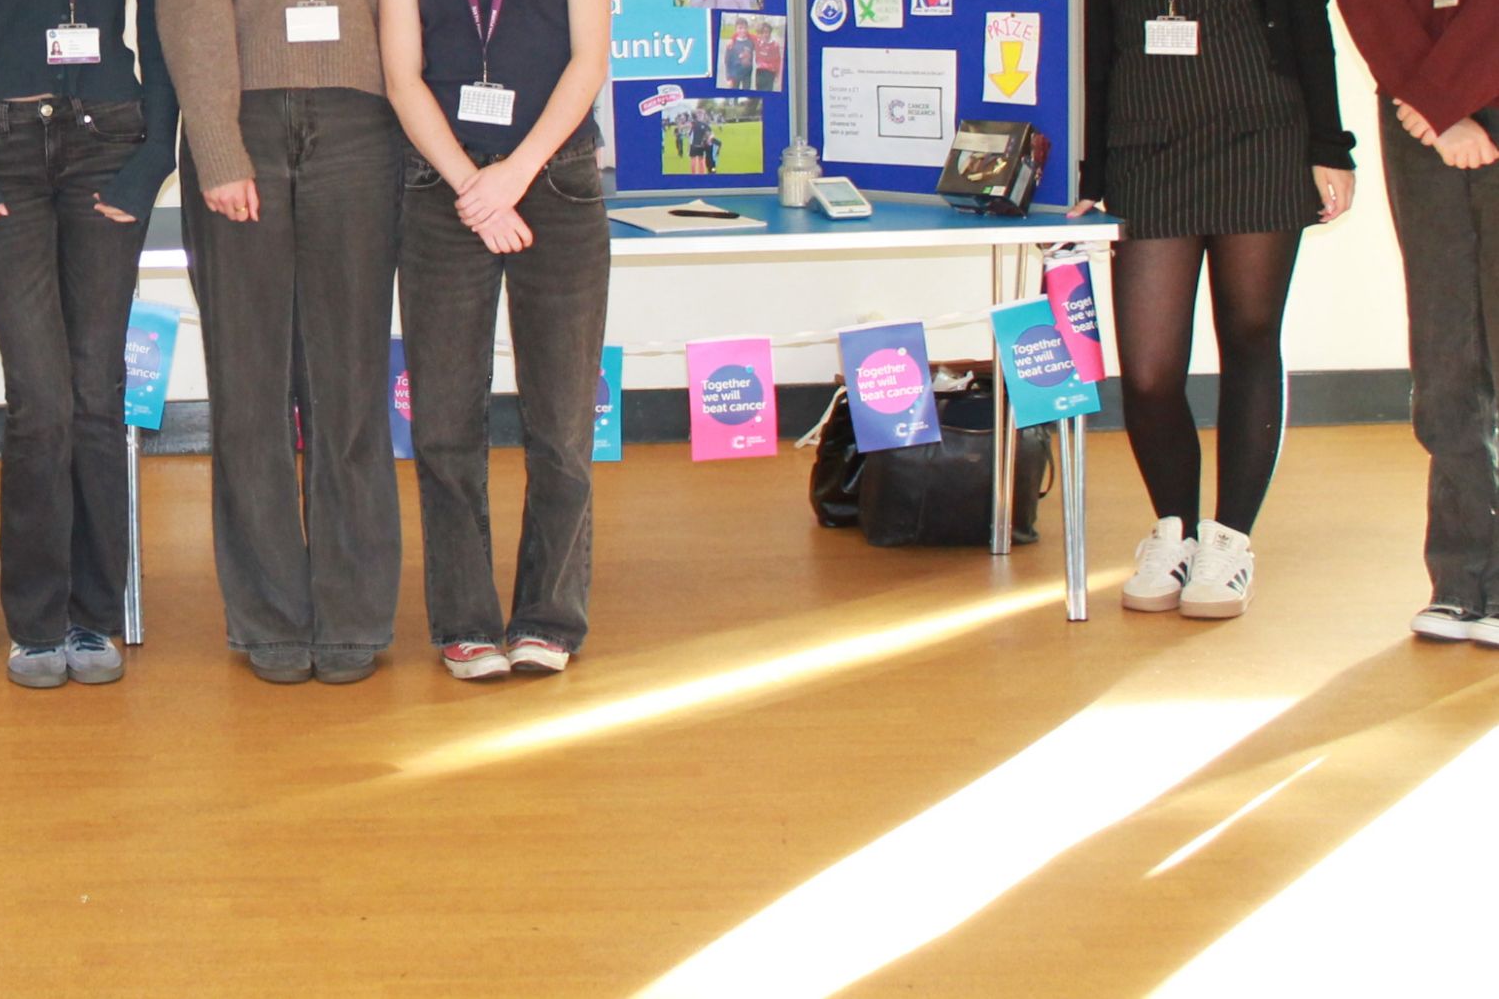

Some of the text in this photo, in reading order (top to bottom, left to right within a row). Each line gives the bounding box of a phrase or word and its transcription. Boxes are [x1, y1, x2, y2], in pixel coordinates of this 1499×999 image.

[987, 16, 1034, 42] PRIZE
[611, 31, 694, 64] unity
[1062, 295, 1093, 313] Toget
[1067, 312, 1085, 323] we
[1072, 322, 1096, 334] beat
[126, 342, 151, 354] ther
[1012, 336, 1063, 356] Together
[125, 354, 138, 364] ill
[1015, 350, 1055, 368] we will
[856, 363, 907, 379] Together
[1017, 358, 1076, 380] beat canc
[701, 378, 751, 393] Together
[858, 375, 898, 391] we will
[702, 390, 742, 402] we will
[859, 384, 925, 403] beat cancer
[595, 404, 614, 414] cer
[702, 401, 767, 414] beat cancer
